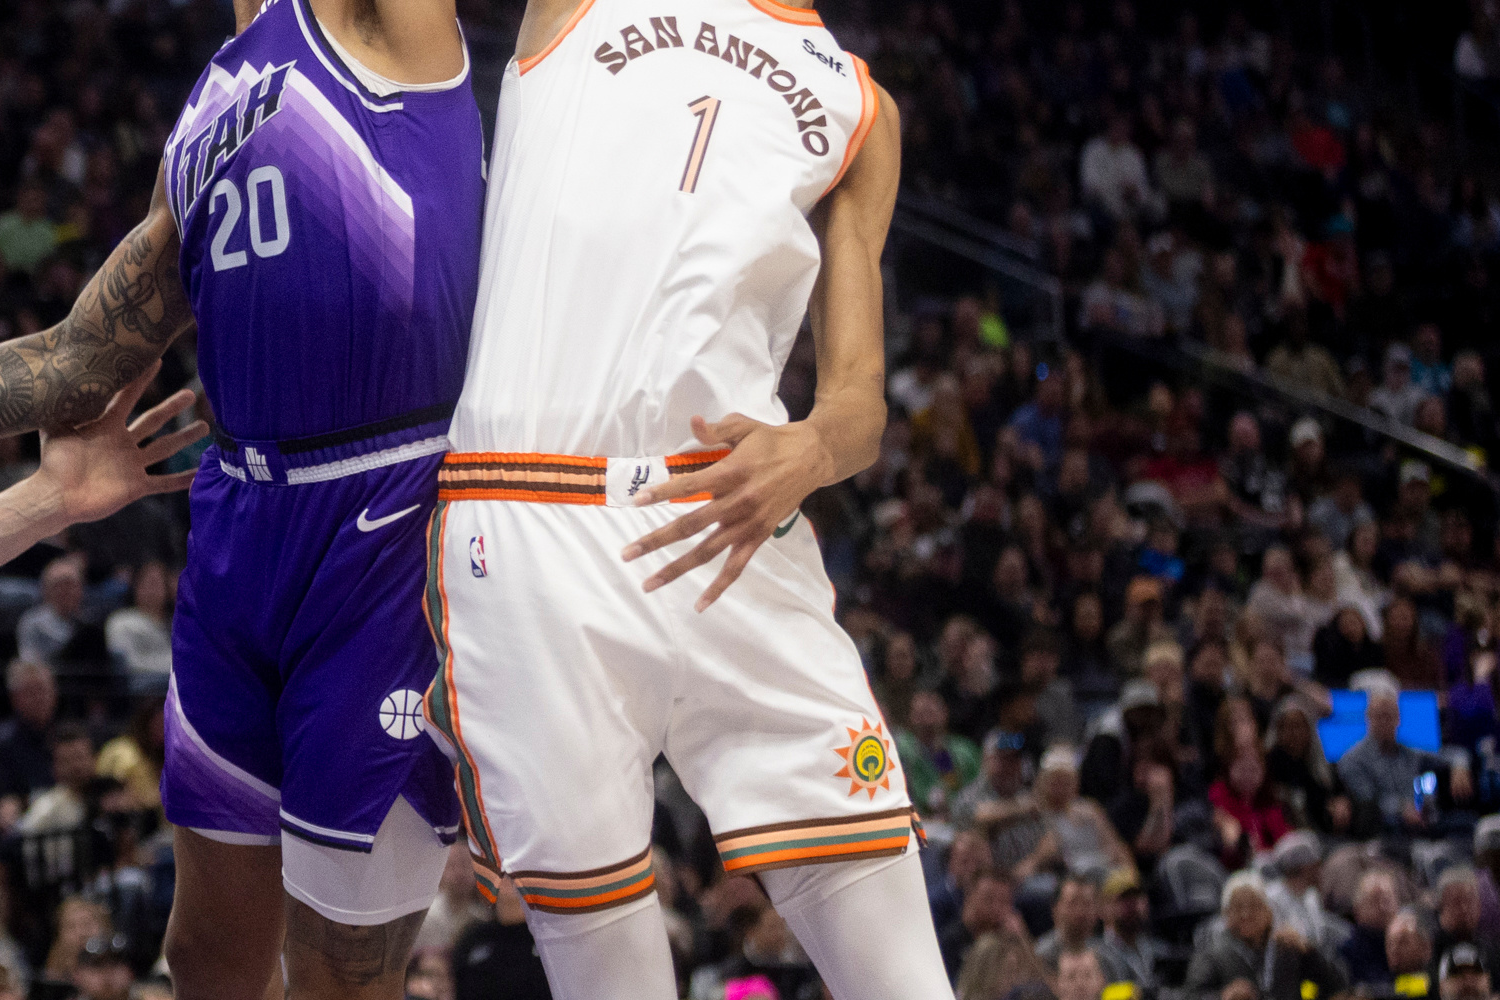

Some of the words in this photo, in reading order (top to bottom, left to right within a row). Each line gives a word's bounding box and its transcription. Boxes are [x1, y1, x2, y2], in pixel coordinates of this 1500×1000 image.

[594, 16, 685, 77] SAN
[693, 21, 831, 158] ANTONIO
[677, 95, 722, 194] 1
[208, 164, 291, 272] 20
